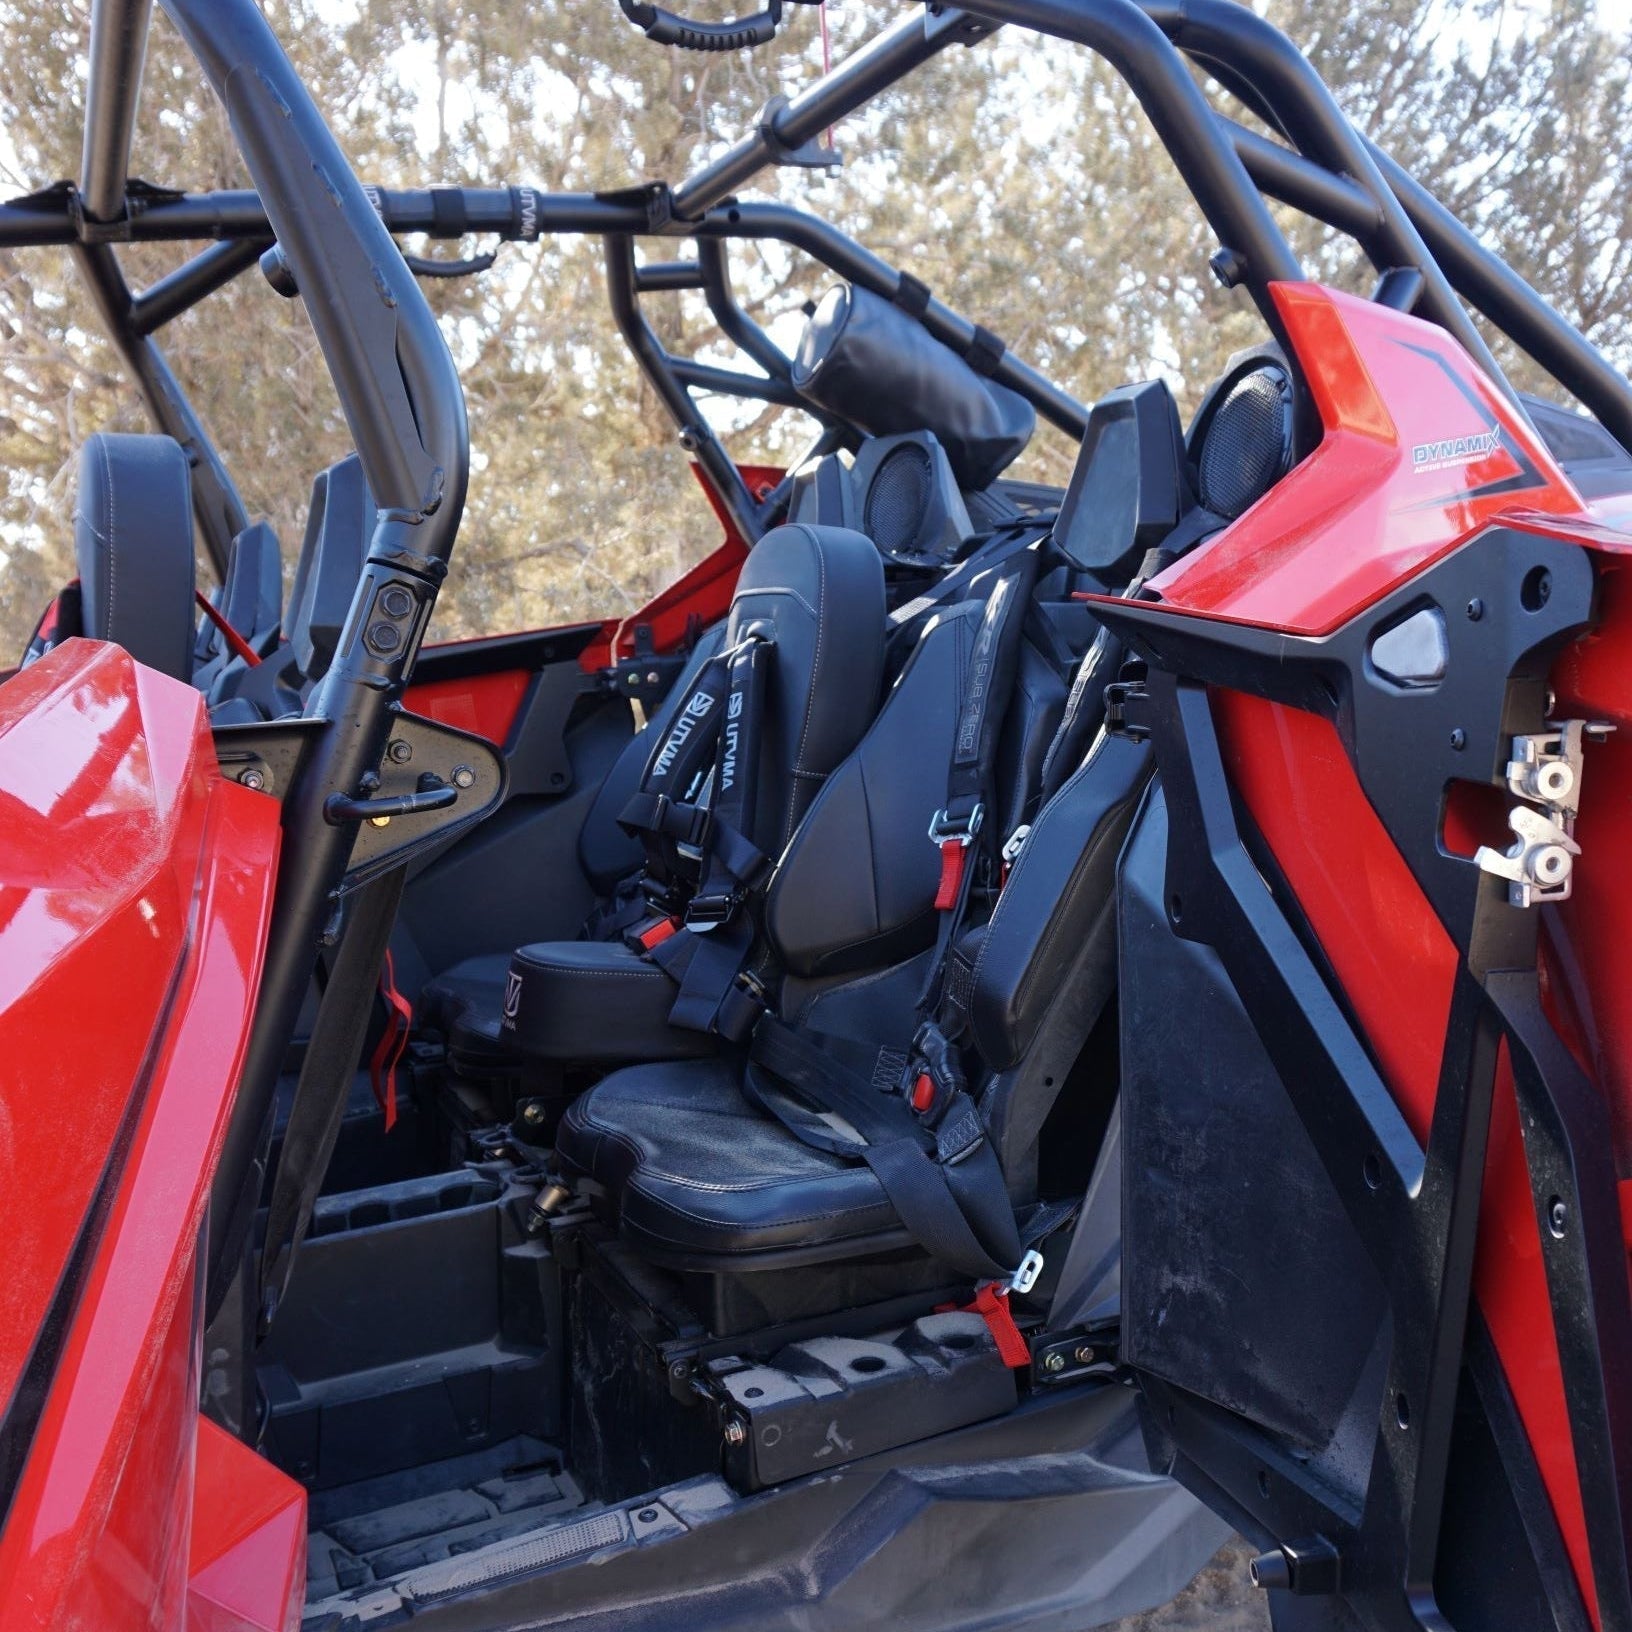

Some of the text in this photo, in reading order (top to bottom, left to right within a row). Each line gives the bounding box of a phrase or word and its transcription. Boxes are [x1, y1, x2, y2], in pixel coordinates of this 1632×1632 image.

[519, 188, 537, 237] UTVMA
[1412, 423, 1500, 464] DYNAMIX
[652, 717, 696, 776] UTVMA
[721, 722, 739, 791] UTVMA
